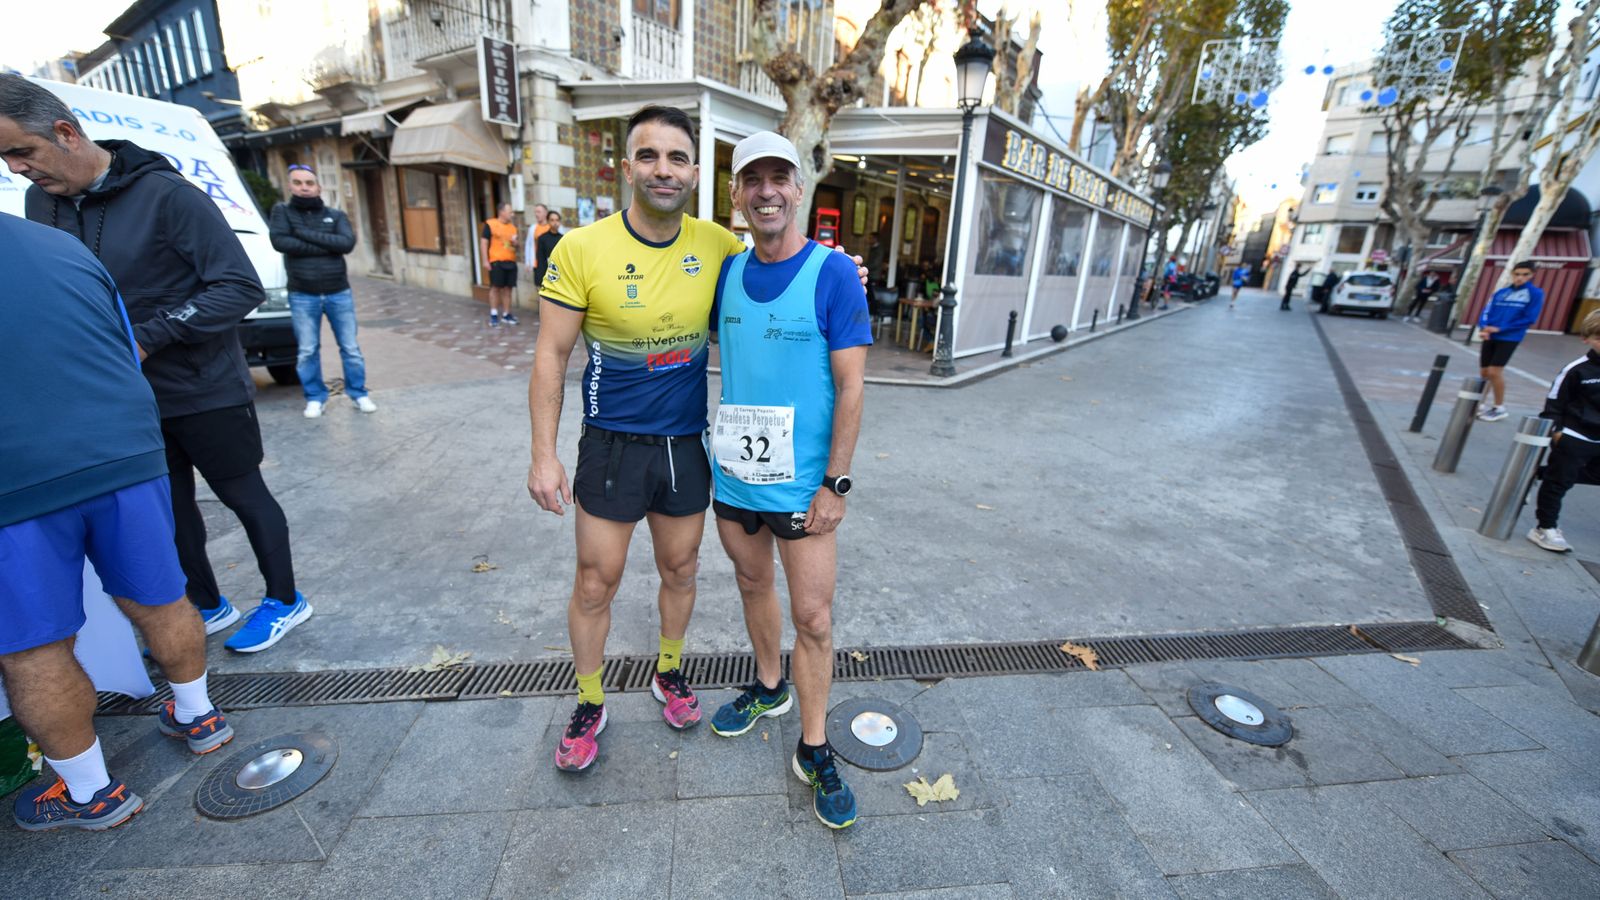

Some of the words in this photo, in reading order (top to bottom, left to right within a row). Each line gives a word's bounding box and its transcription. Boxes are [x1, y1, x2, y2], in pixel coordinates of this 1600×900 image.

[71, 107, 144, 130] ADIS
[150, 122, 196, 142] 2.0
[1002, 129, 1048, 181] BAR
[1045, 152, 1072, 191] DE
[725, 316, 741, 324] joma
[651, 332, 700, 346] Vepersa
[647, 348, 692, 367] FROIZ
[740, 435, 771, 463] 32
